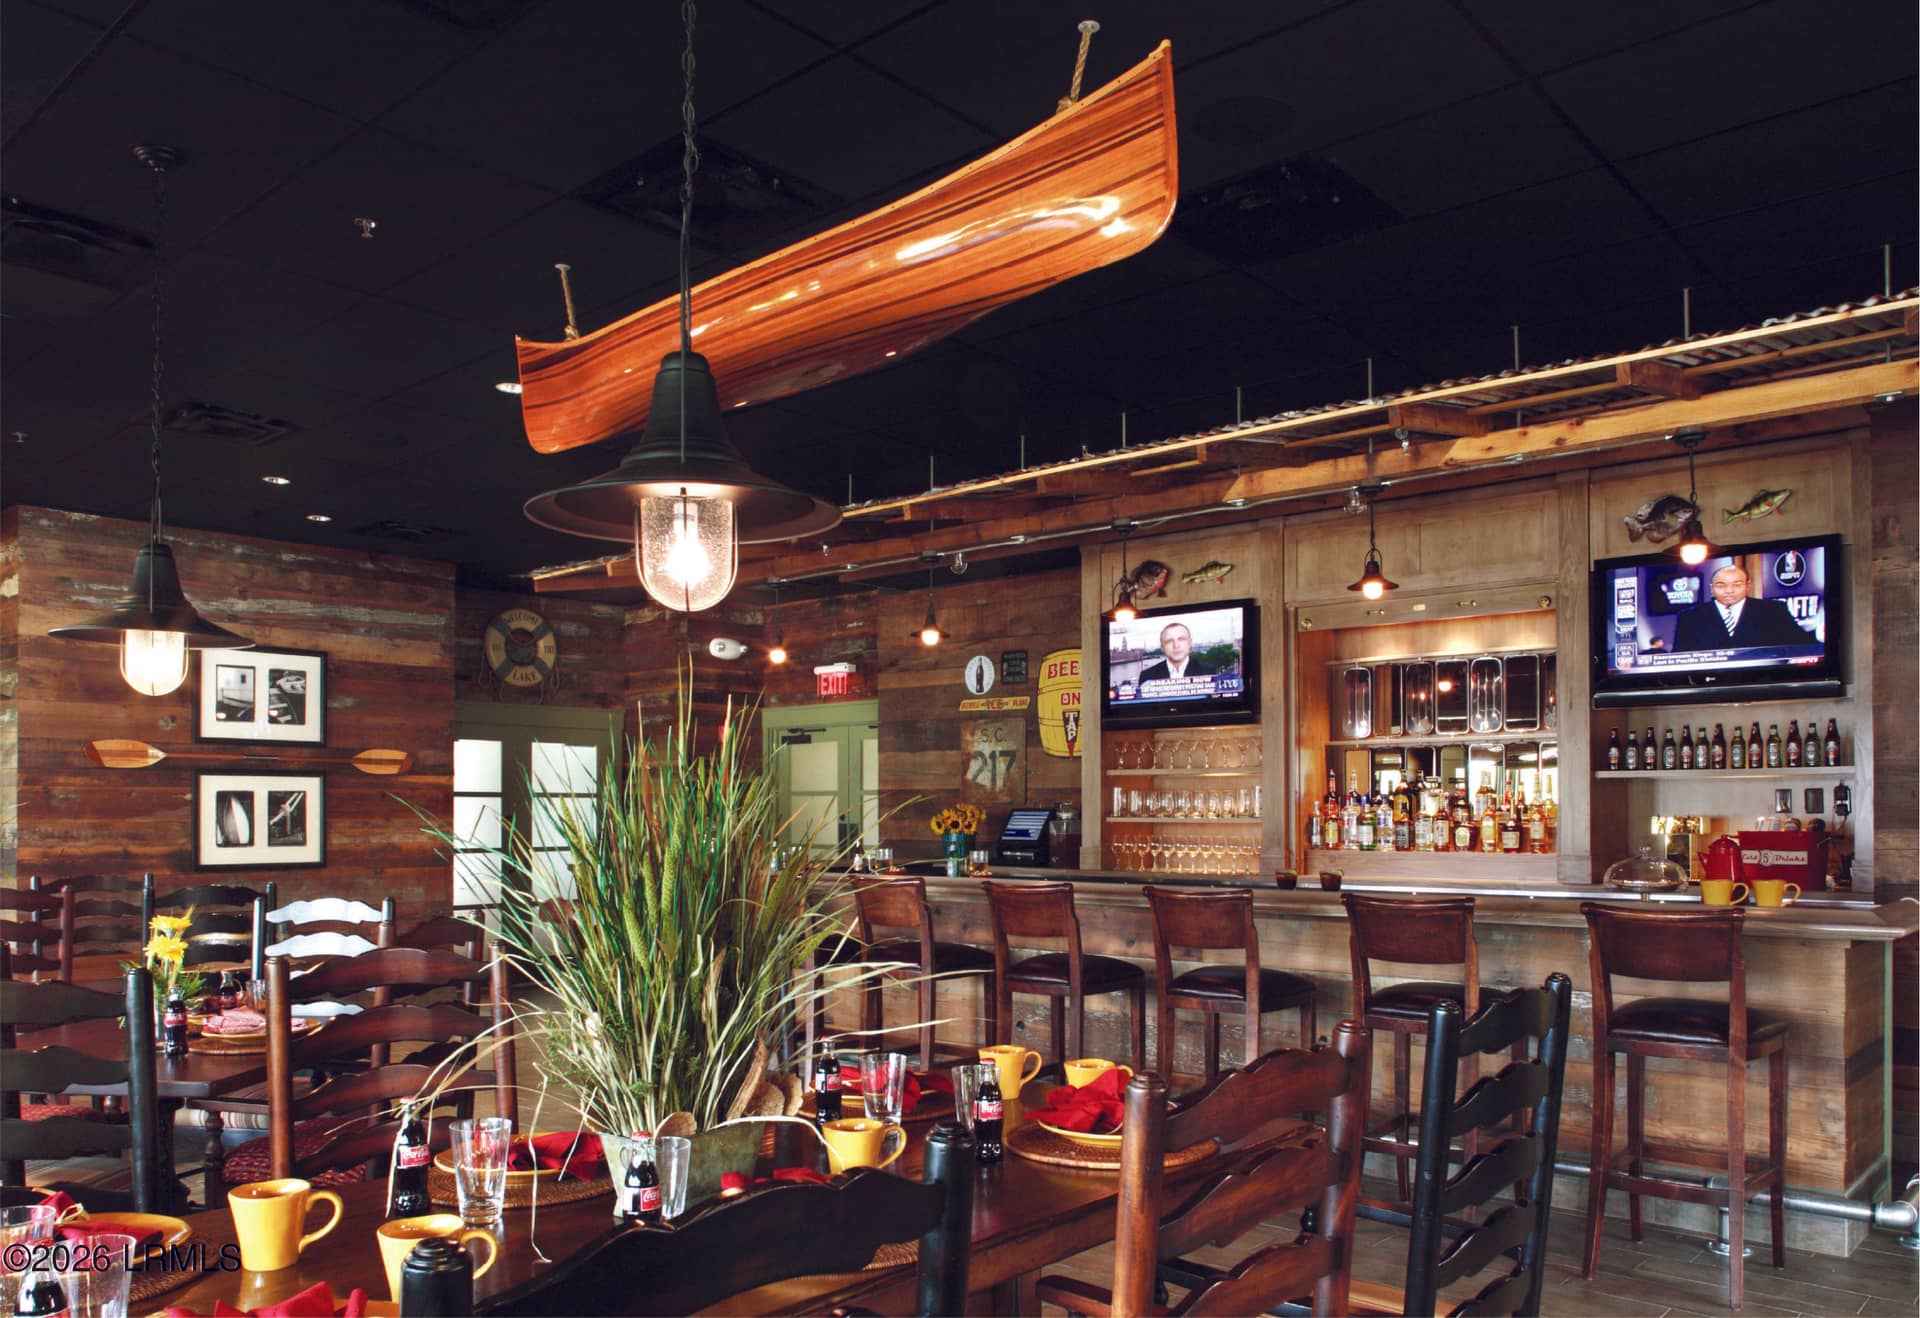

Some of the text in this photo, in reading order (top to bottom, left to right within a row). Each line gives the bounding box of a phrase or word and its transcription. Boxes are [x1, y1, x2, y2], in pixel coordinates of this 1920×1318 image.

[1047, 660, 1080, 679] BEE
[820, 673, 847, 695] EXIT
[1060, 692, 1081, 706] ON
[980, 727, 1008, 743] S.C.
[1064, 711, 1079, 741] TAP
[971, 750, 1017, 788] 217
[1775, 854, 1805, 862] Drinks
